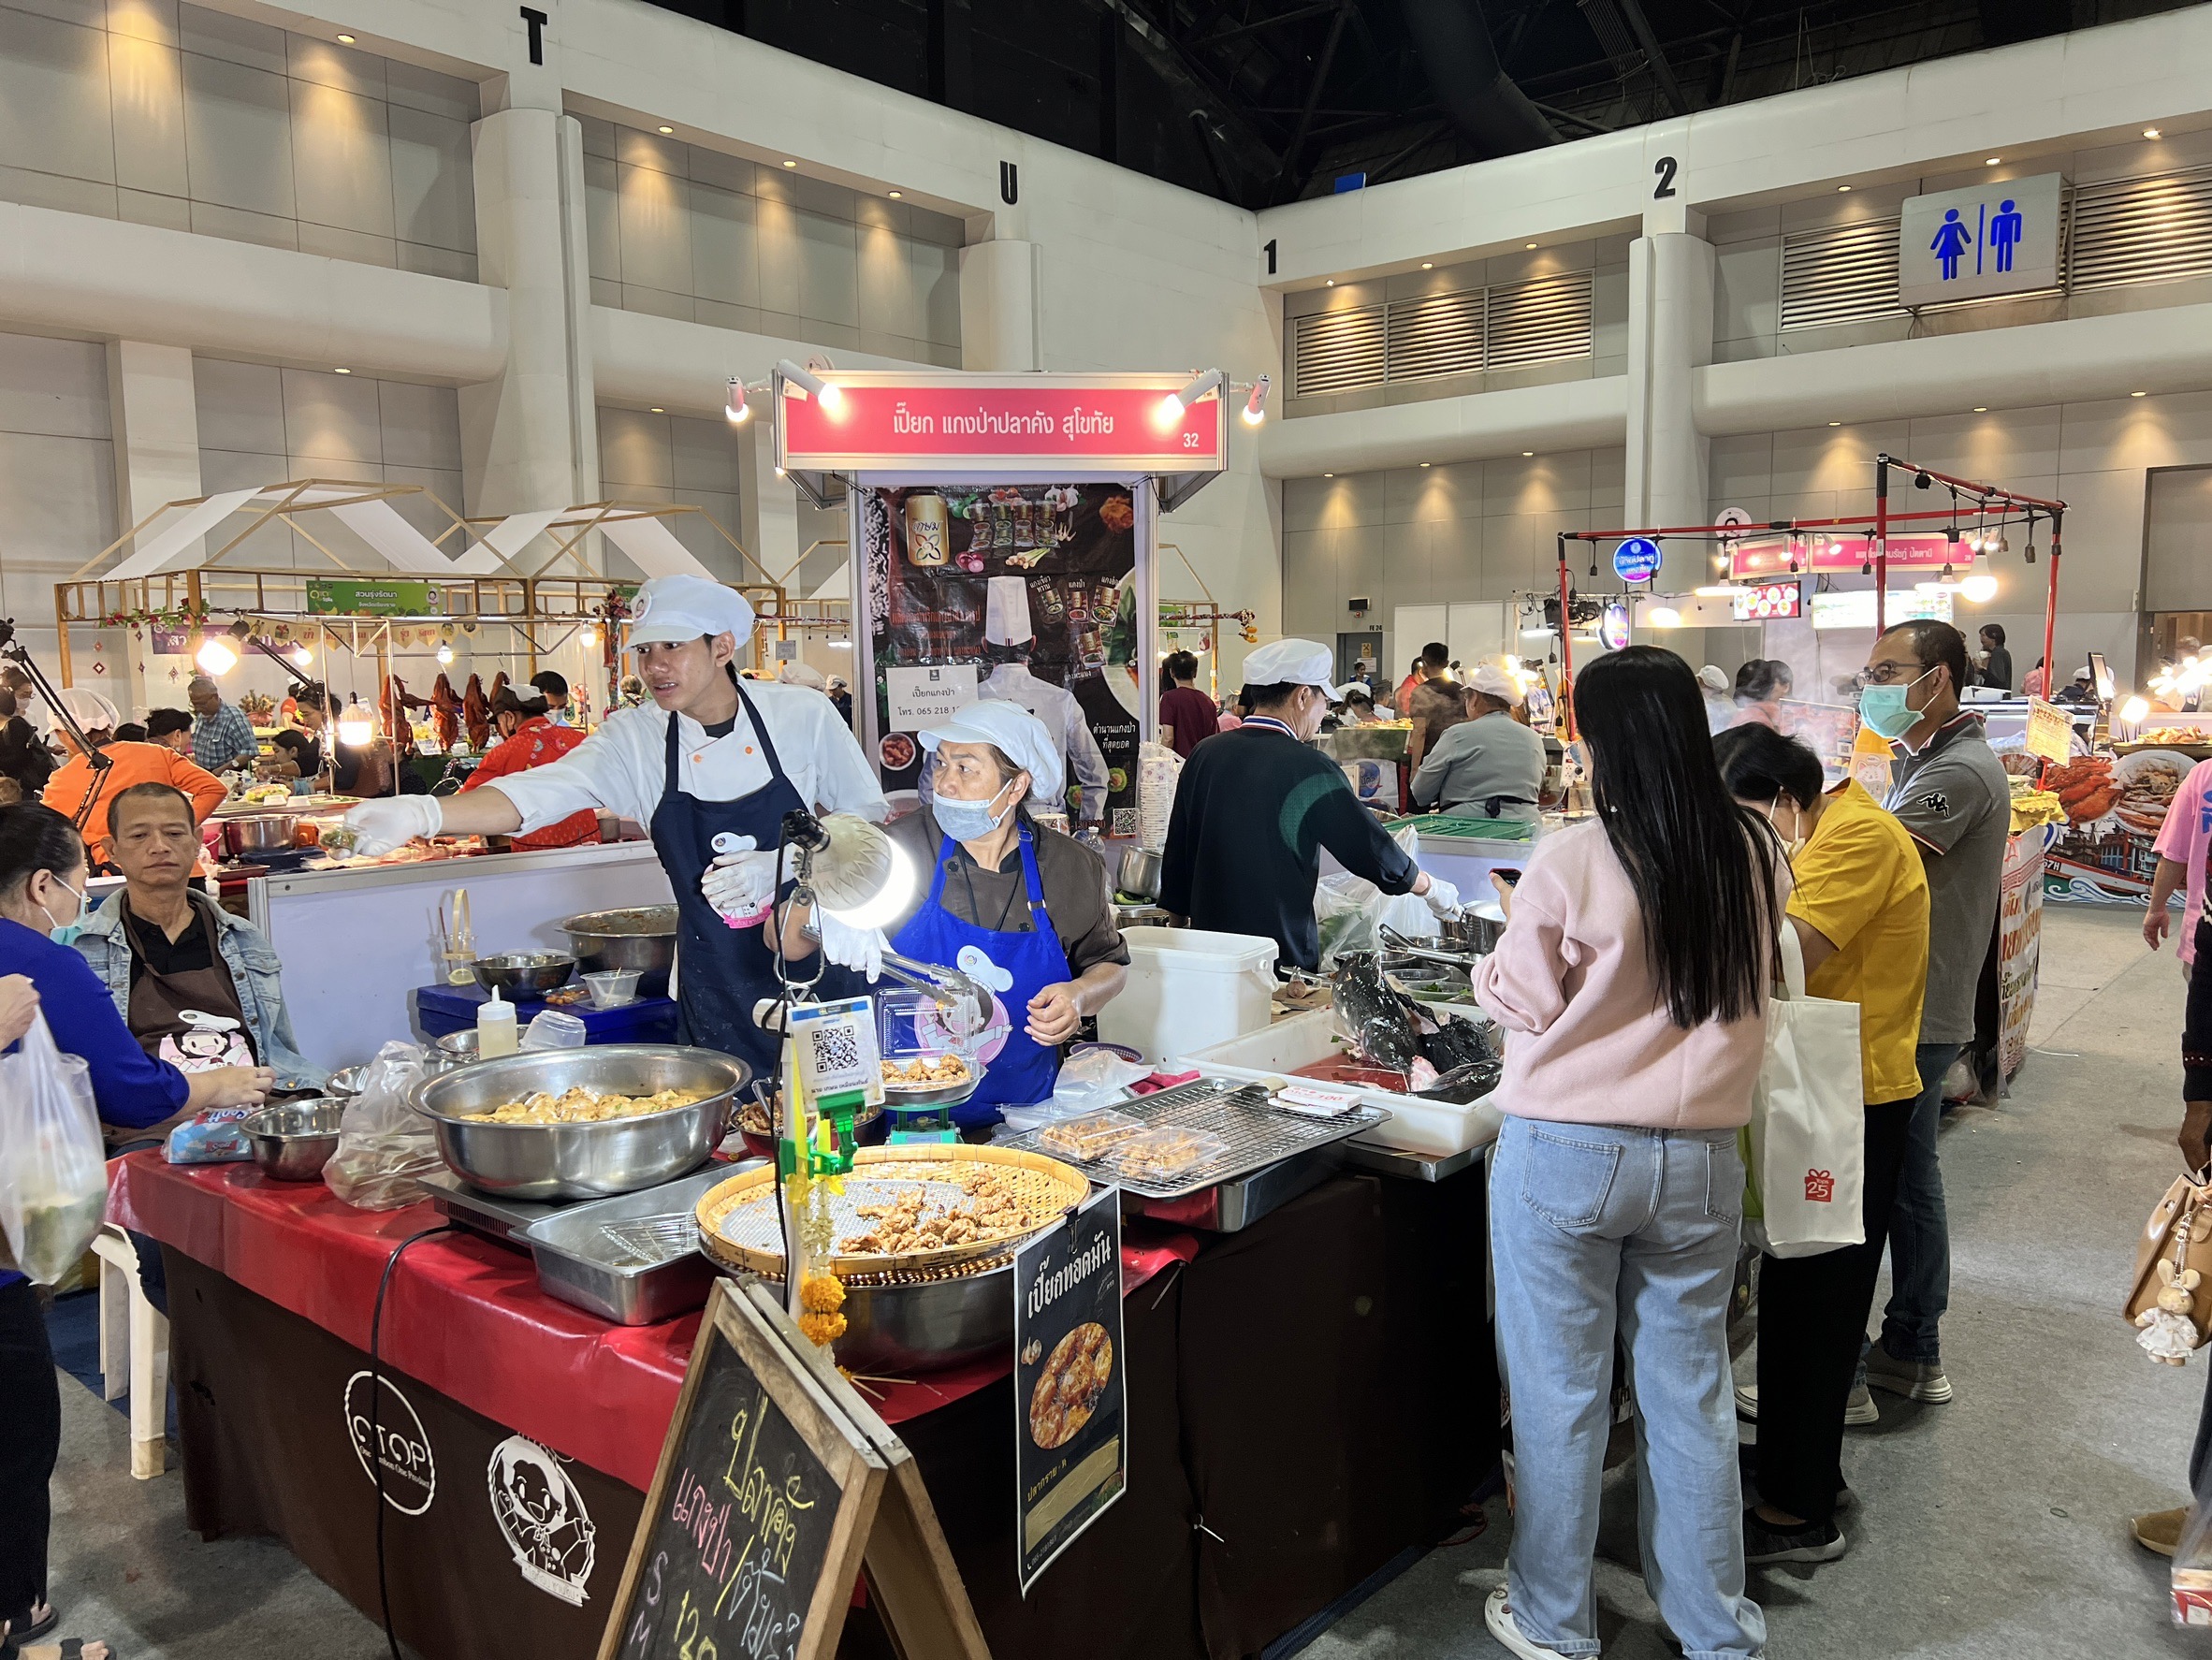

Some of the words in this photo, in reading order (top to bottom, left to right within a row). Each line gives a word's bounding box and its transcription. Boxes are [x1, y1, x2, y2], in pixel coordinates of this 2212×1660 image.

[520, 6, 547, 66] T
[999, 160, 1018, 206] U
[1653, 156, 1678, 199] 2
[1263, 239, 1278, 275] 1
[893, 401, 935, 435] เปี๊ยก
[941, 406, 1055, 435] แกงป่าปลาคัง
[1062, 406, 1113, 442] สุโขทัย
[1183, 432, 1200, 448] 32
[911, 685, 955, 698] เปี๊ยกแกงป่า
[897, 706, 914, 716] โทร.
[1093, 721, 1136, 735] ตำนานแกงป่า
[1102, 735, 1130, 753] ที่สุดยอด
[1806, 1181, 1829, 1199] 25
[1027, 1230, 1112, 1319] เปี๊ยกทอดมัน
[646, 1551, 669, 1607] S
